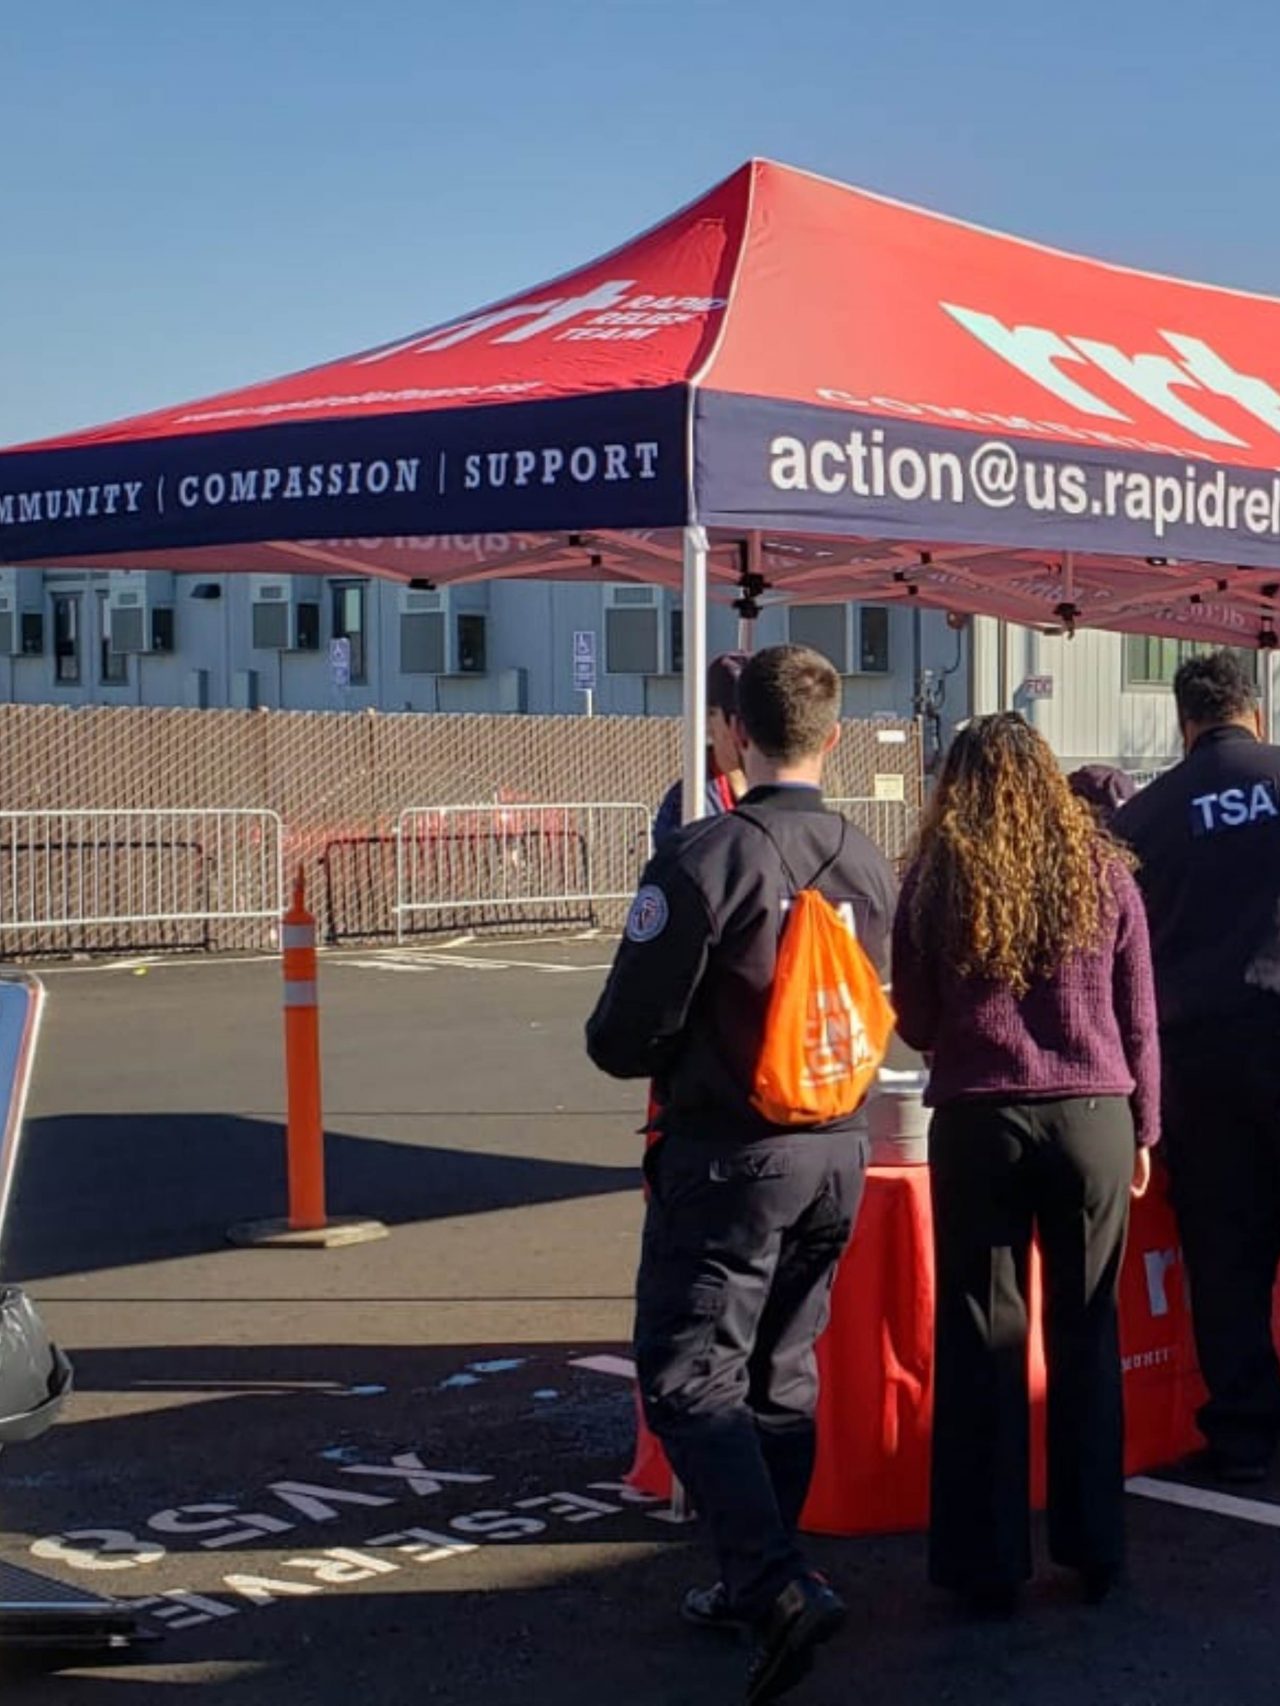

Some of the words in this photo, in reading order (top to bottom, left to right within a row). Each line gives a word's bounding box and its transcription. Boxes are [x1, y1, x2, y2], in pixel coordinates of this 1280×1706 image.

[179, 458, 420, 507] COMPASSION
[464, 442, 658, 489] SUPPORT
[1192, 784, 1279, 829] TSA
[128, 1483, 668, 1637] RESERVE
